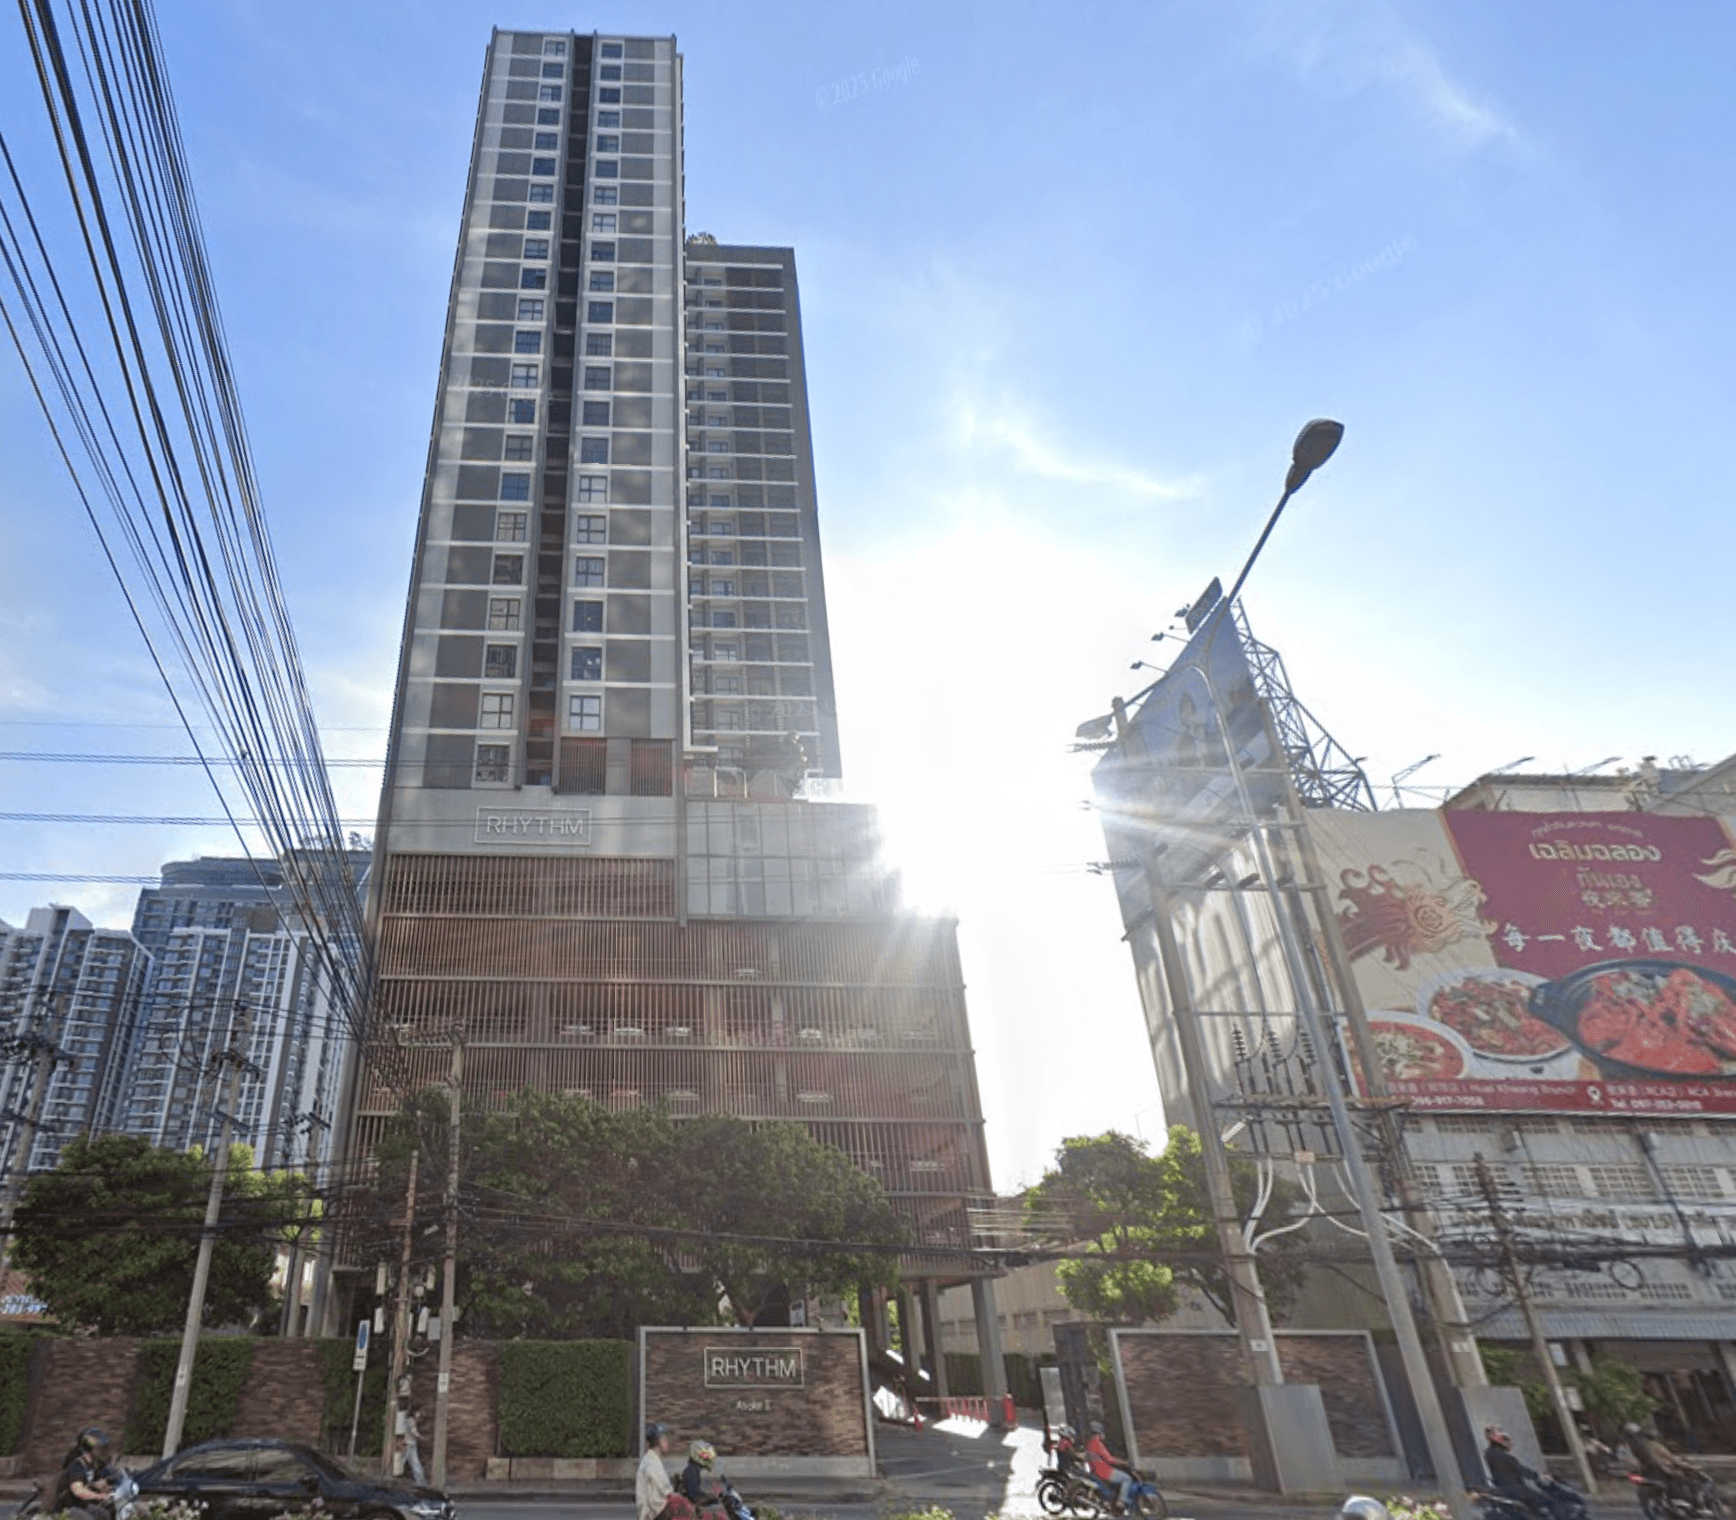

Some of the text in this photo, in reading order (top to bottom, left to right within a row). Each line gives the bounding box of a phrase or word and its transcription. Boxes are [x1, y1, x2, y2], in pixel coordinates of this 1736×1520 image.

[486, 815, 584, 836] RHYTHM
[1528, 839, 1662, 863] เฉลิมฉลอง
[711, 1357, 797, 1378] RHYTHM
